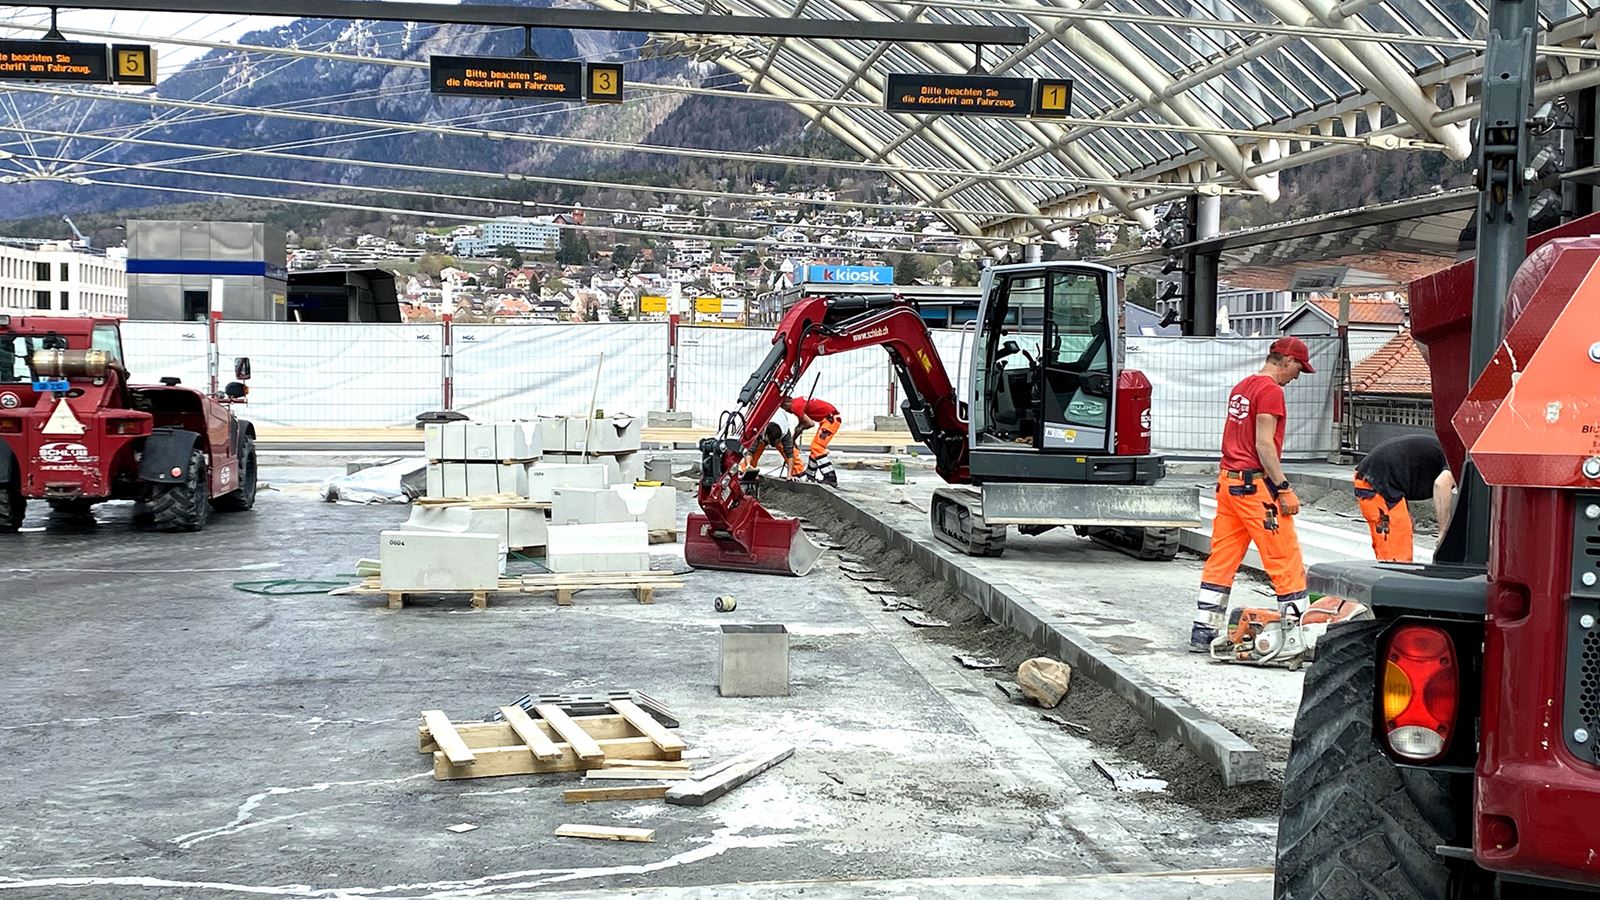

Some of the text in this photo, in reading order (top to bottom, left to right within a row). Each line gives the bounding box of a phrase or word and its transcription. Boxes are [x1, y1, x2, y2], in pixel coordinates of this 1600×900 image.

[11, 53, 53, 62] beachten
[56, 55, 70, 63] Sie
[126, 54, 138, 72] 5
[30, 64, 44, 72] am
[48, 63, 91, 74] Fahrzeug.
[465, 69, 547, 81] Bitte beachten Sie
[446, 78, 566, 92] die Anschrift am Fahrzeug.
[600, 72, 611, 90] 3
[921, 86, 999, 97] Bitte beachten Sie
[1050, 87, 1058, 106] 1
[902, 95, 916, 103] die
[918, 96, 957, 105] Anschrift
[976, 97, 1017, 108] Fahrzeug.
[824, 268, 880, 281] k kiosk
[3, 397, 16, 406] 25
